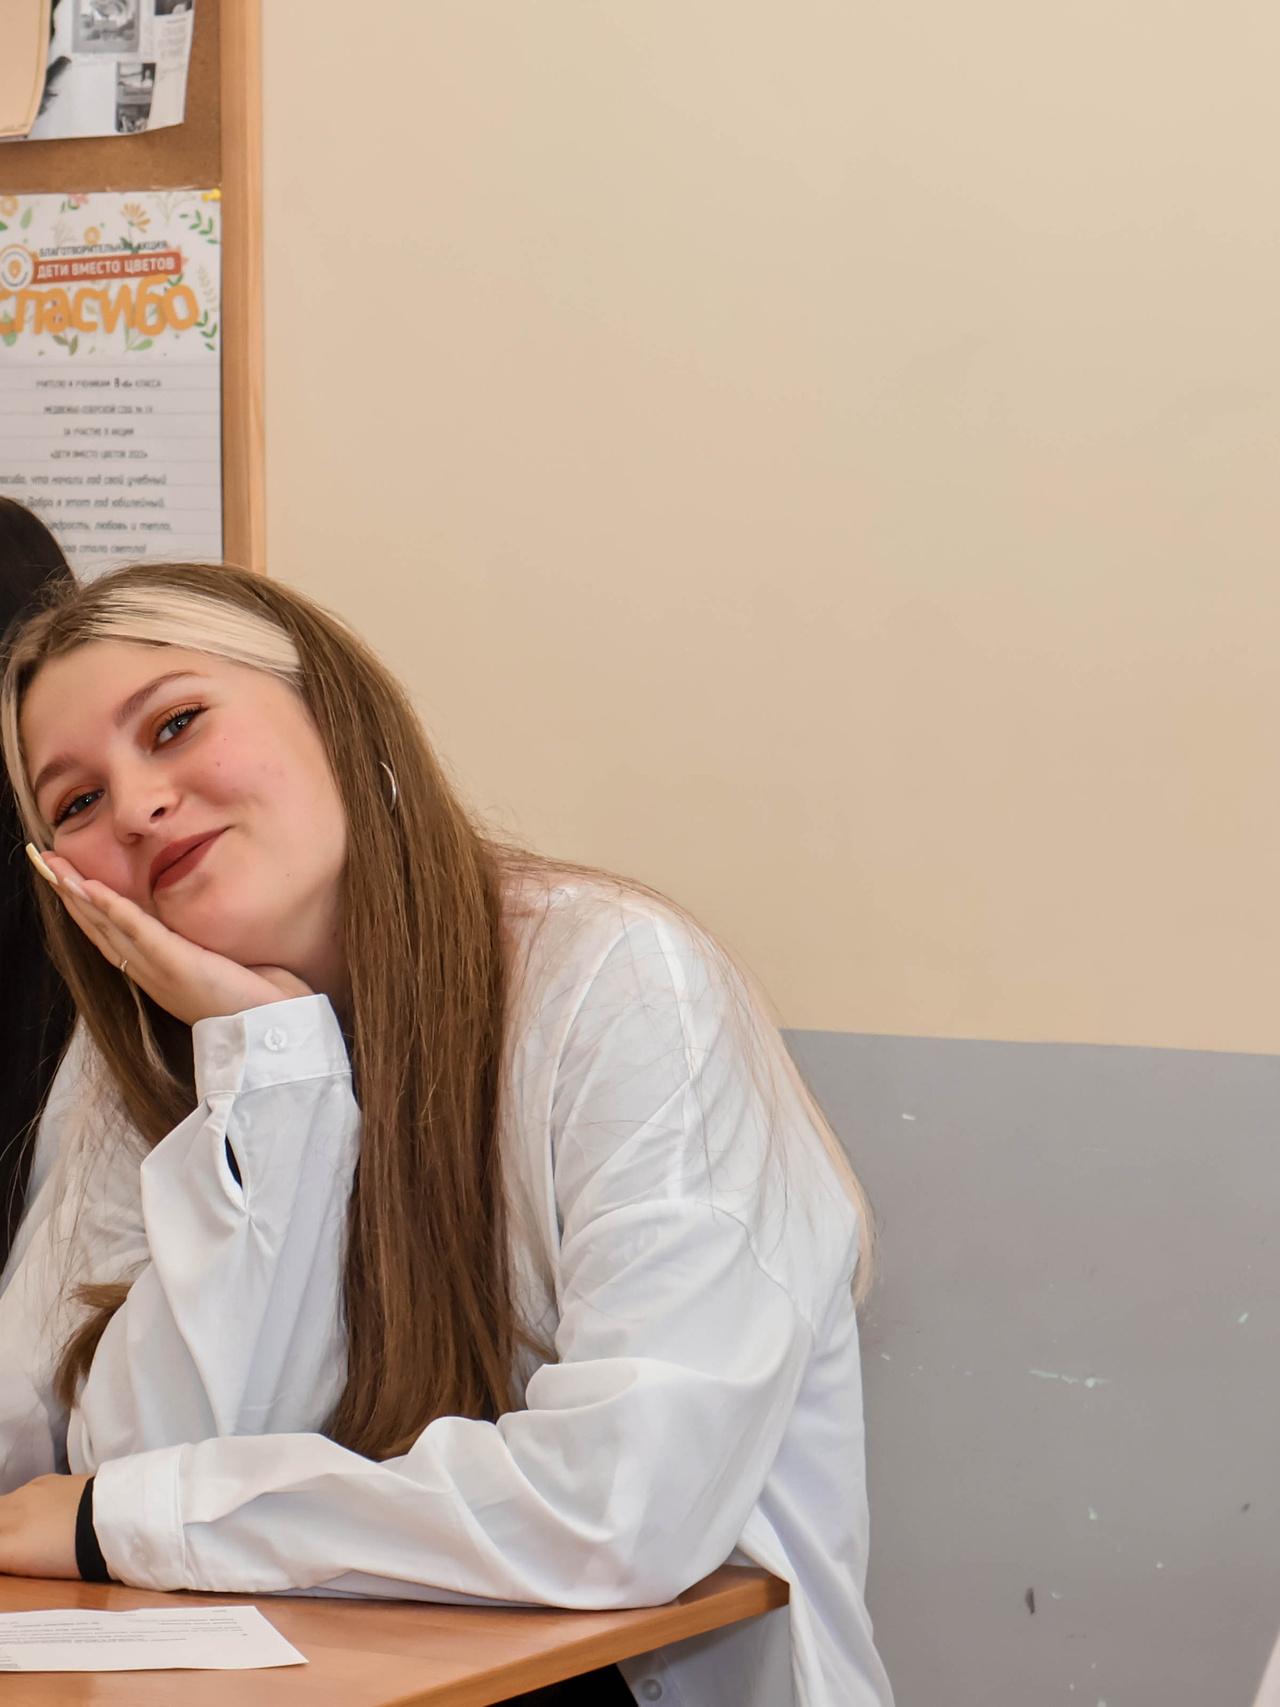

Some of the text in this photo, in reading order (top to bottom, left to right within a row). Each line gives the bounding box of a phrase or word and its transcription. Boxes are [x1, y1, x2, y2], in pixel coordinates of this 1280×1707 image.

[37, 263, 70, 280] ДЕТИ
[71, 259, 121, 276] ВМЕСТО
[123, 255, 176, 274] ЦВЕТОВ
